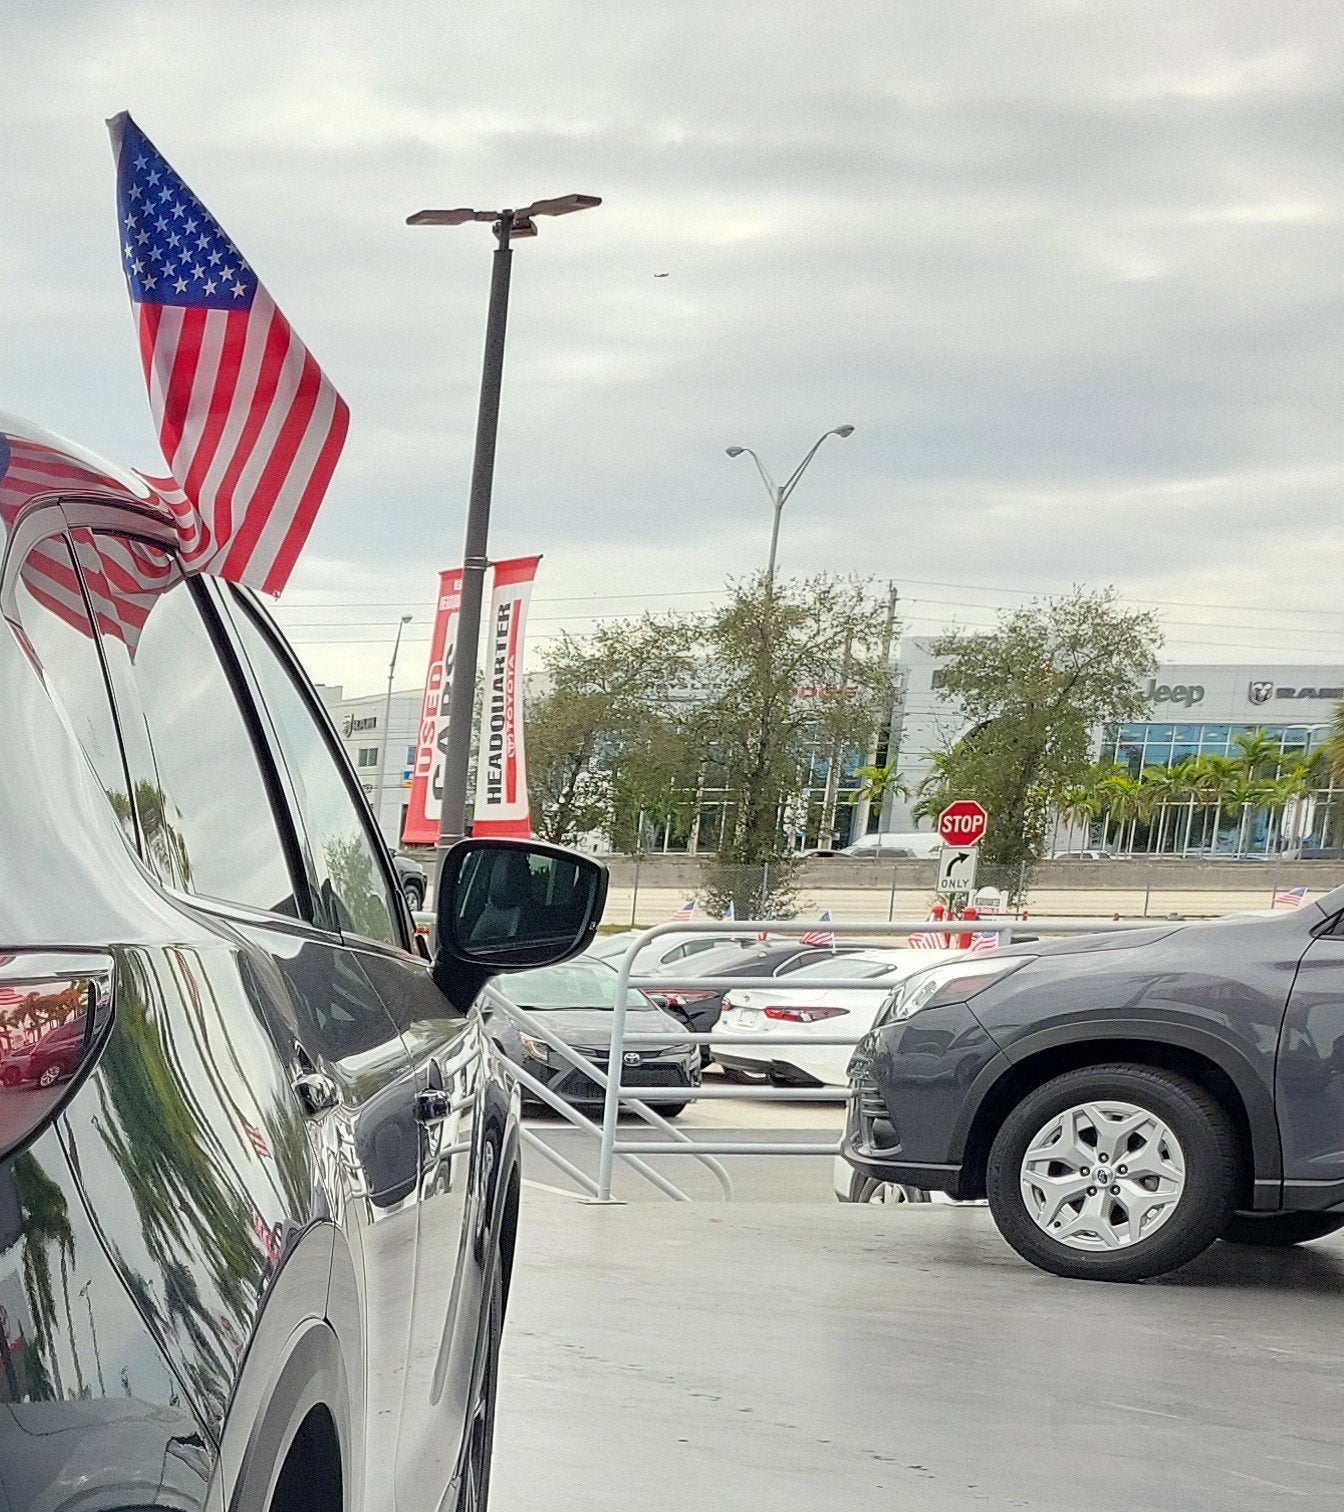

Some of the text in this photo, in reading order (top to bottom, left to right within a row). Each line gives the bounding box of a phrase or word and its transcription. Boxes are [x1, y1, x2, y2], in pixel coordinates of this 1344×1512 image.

[415, 661, 443, 776] USED
[487, 602, 511, 804] HEADQUARTER
[505, 655, 516, 730] TOYOTA
[1141, 679, 1206, 708] Jeep
[941, 815, 983, 834] STOP
[941, 879, 969, 889] ONLY
